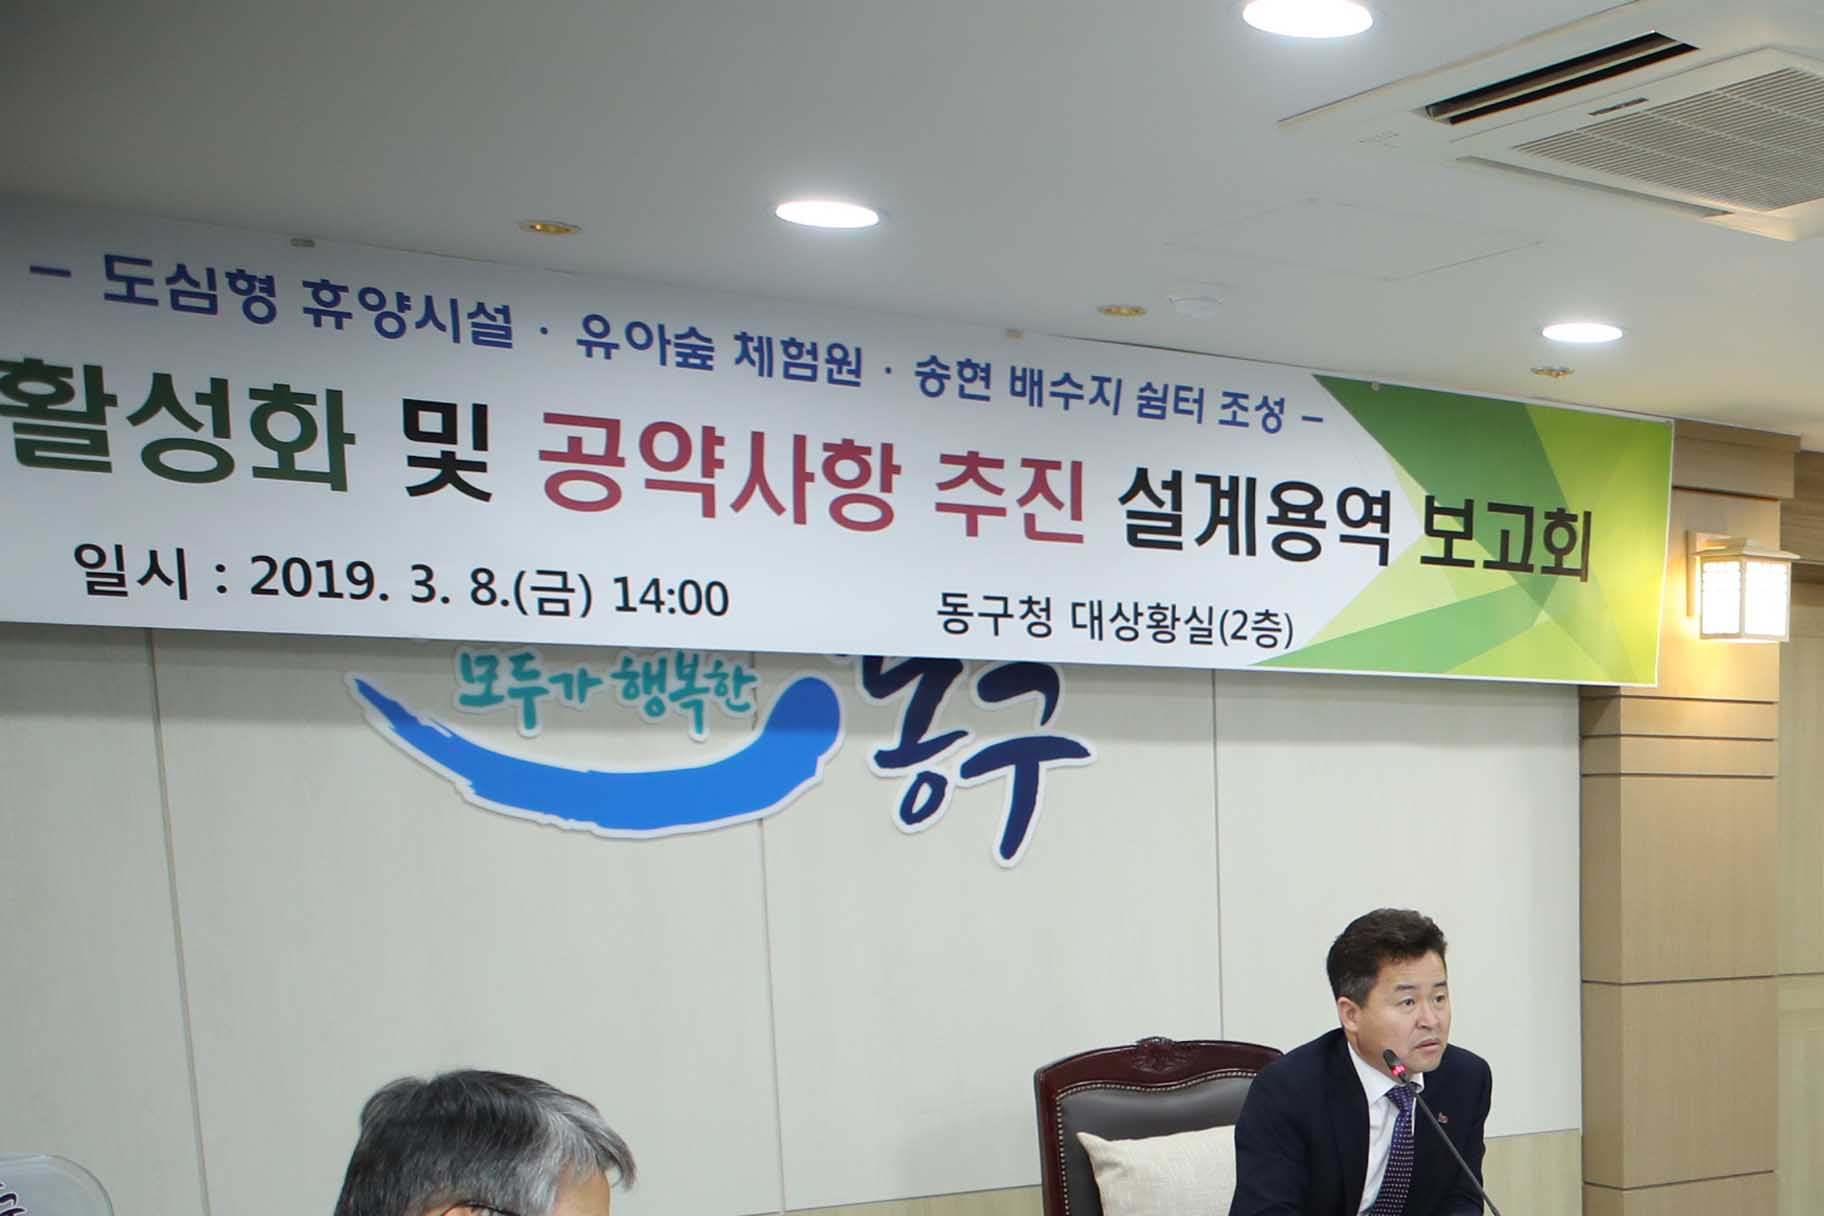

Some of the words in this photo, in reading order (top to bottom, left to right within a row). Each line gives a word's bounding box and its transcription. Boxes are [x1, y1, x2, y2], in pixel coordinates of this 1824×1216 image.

[102, 250, 279, 326] 도심형
[301, 277, 514, 349] 휴양시설
[575, 313, 718, 372] 유아숲
[730, 327, 865, 389] 체험원
[912, 352, 994, 404] 송현
[1007, 363, 1124, 418] 배수지
[1134, 379, 1206, 426] 쉼터
[1216, 388, 1287, 436] 조성
[0, 356, 357, 493] 활성화
[398, 395, 494, 504] 및
[537, 410, 903, 533] 공약사항
[933, 448, 1086, 546] 추진
[1117, 466, 1394, 568] 설계용역
[1419, 494, 1593, 583] 보고회
[72, 541, 190, 602] 일시
[248, 553, 391, 604] 2019.
[409, 562, 452, 606] 3.
[468, 565, 594, 620] 8.(금)
[611, 574, 731, 619] 14:00
[934, 590, 1054, 640] 동구청
[1069, 598, 1301, 655] 대상황실(2층)
[459, 652, 603, 730] 모두가
[610, 650, 757, 734] 행복한
